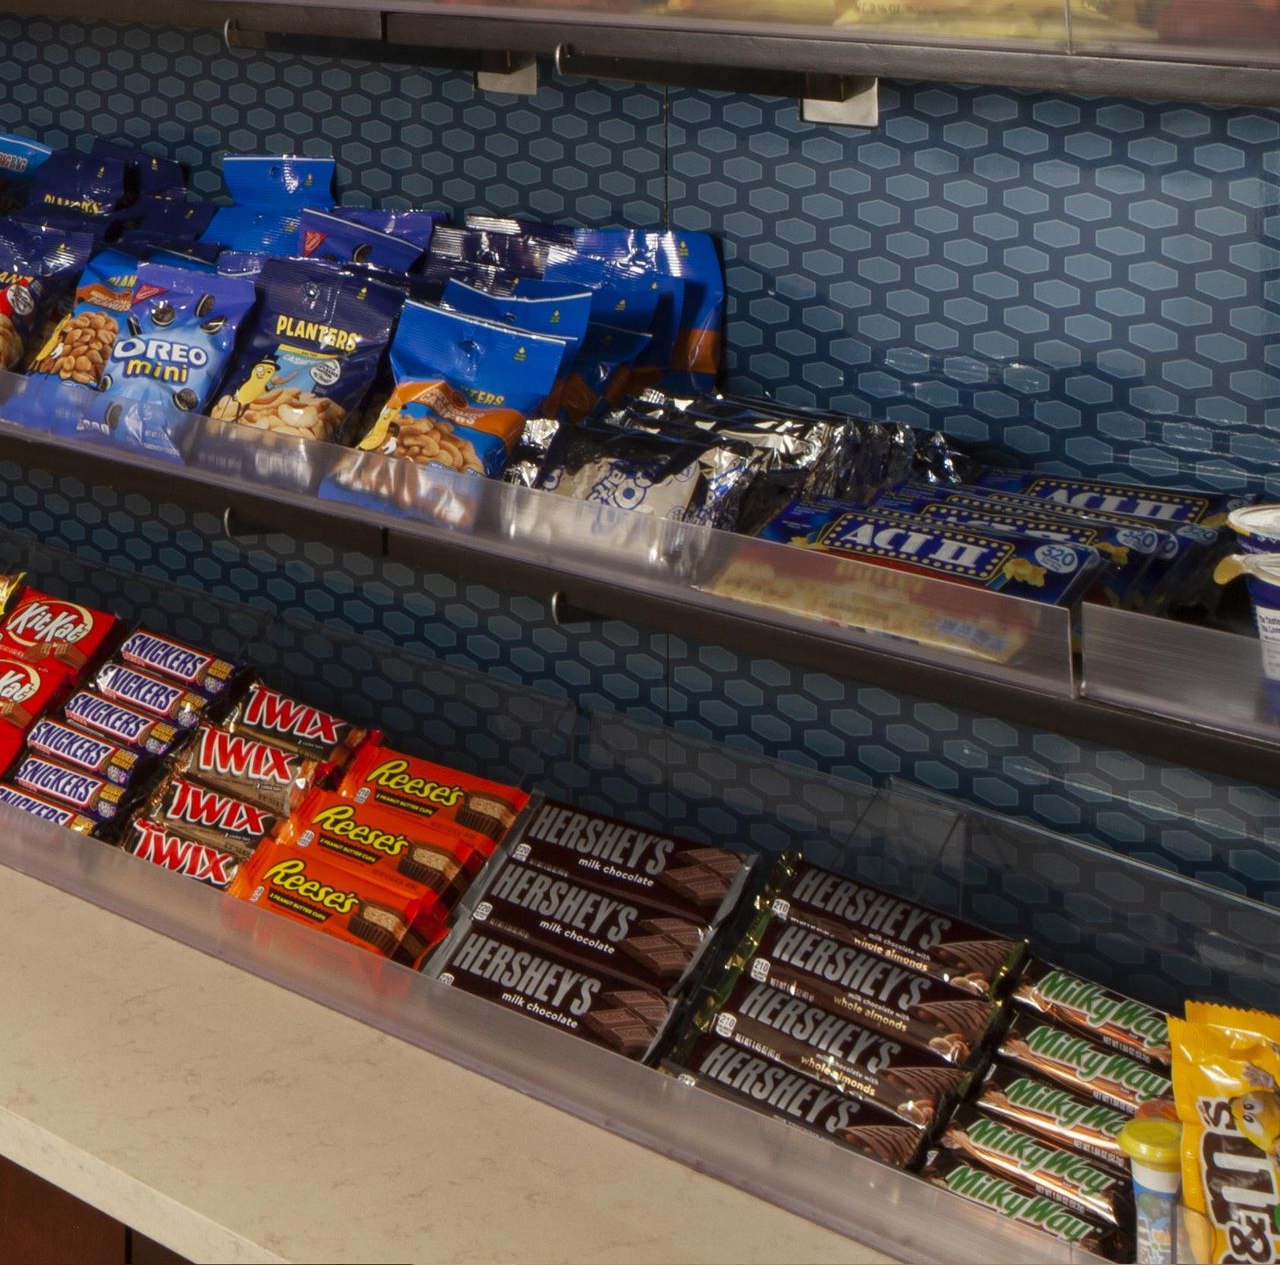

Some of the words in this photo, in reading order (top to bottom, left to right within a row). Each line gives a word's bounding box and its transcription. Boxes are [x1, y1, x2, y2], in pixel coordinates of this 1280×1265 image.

[114, 338, 207, 367] OREO
[276, 314, 358, 352] PLANTERS
[126, 358, 188, 384] mini
[1045, 488, 1128, 513] ACT
[1133, 499, 1184, 522] II
[839, 523, 934, 555] ACT
[928, 538, 989, 568] II
[1042, 544, 1075, 568] 320
[121, 632, 212, 680] SNICKERS
[68, 692, 152, 740] SNICKERS
[243, 684, 345, 746] TWIX
[30, 721, 117, 770] SNICKERS
[199, 724, 297, 786] TWIX
[16, 757, 101, 804] SNICKERS
[366, 759, 465, 809] Reese's
[381, 794, 399, 806] PEANUT
[399, 800, 417, 812] BUTTER
[170, 777, 269, 837] TWIX
[133, 818, 236, 887] TWIX
[312, 805, 410, 859] Reese's
[527, 804, 675, 877] HERSHEY'S
[263, 859, 360, 916] Reese's
[578, 856, 602, 872] milk
[602, 864, 655, 888] chocolate
[490, 862, 639, 943] HERSHEY'S
[773, 900, 789, 913] 210
[792, 868, 953, 950] HERSHEY'S
[539, 918, 563, 935] milk
[563, 926, 616, 955] chocolate
[853, 935, 885, 956] whole
[884, 946, 929, 972] almonds
[883, 935, 917, 956] chocolate
[452, 932, 602, 1016] HERSHEY'S
[754, 958, 770, 972] 210
[772, 924, 932, 1012] HERSHEY'S
[501, 990, 525, 1008] milk
[525, 1001, 579, 1030] chocolate
[833, 994, 864, 1015] whole
[864, 1007, 908, 1034] almonds
[863, 995, 896, 1016] chocolate
[739, 985, 902, 1075] HERSHEY'S
[698, 1042, 862, 1134] HERSHEY'S
[800, 1054, 831, 1078] whole
